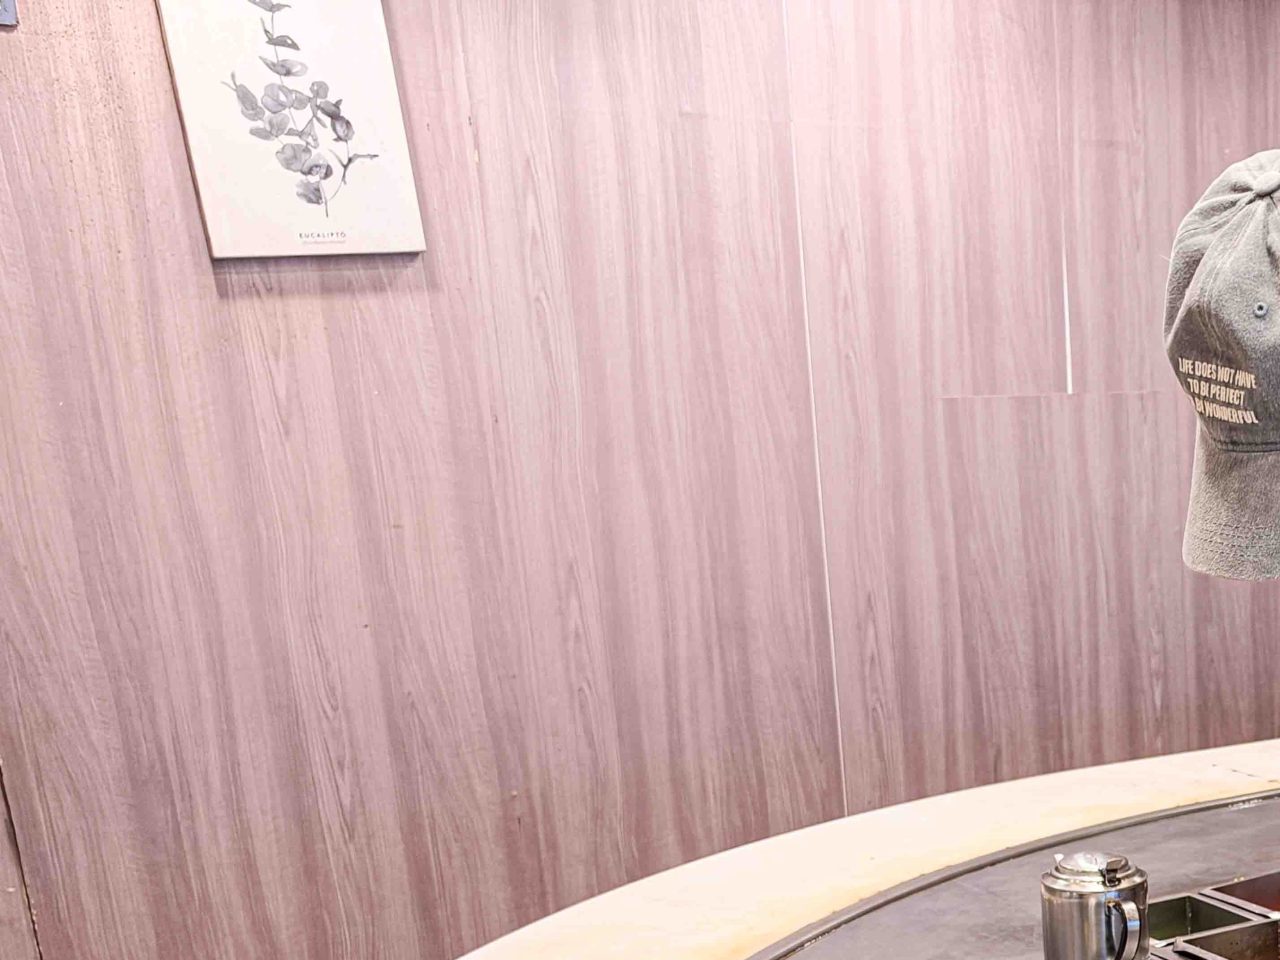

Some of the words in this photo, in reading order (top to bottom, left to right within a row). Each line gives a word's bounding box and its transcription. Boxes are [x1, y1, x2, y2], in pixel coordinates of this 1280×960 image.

[1178, 357, 1194, 374] LIFE
[1195, 361, 1217, 380] DOES
[1218, 365, 1235, 384] NOT
[1235, 369, 1257, 389] HAVE
[1187, 378, 1199, 394] TO
[1200, 382, 1210, 398] BE
[1210, 384, 1245, 406] PERFECT
[1204, 401, 1259, 424] WONDERFUL
